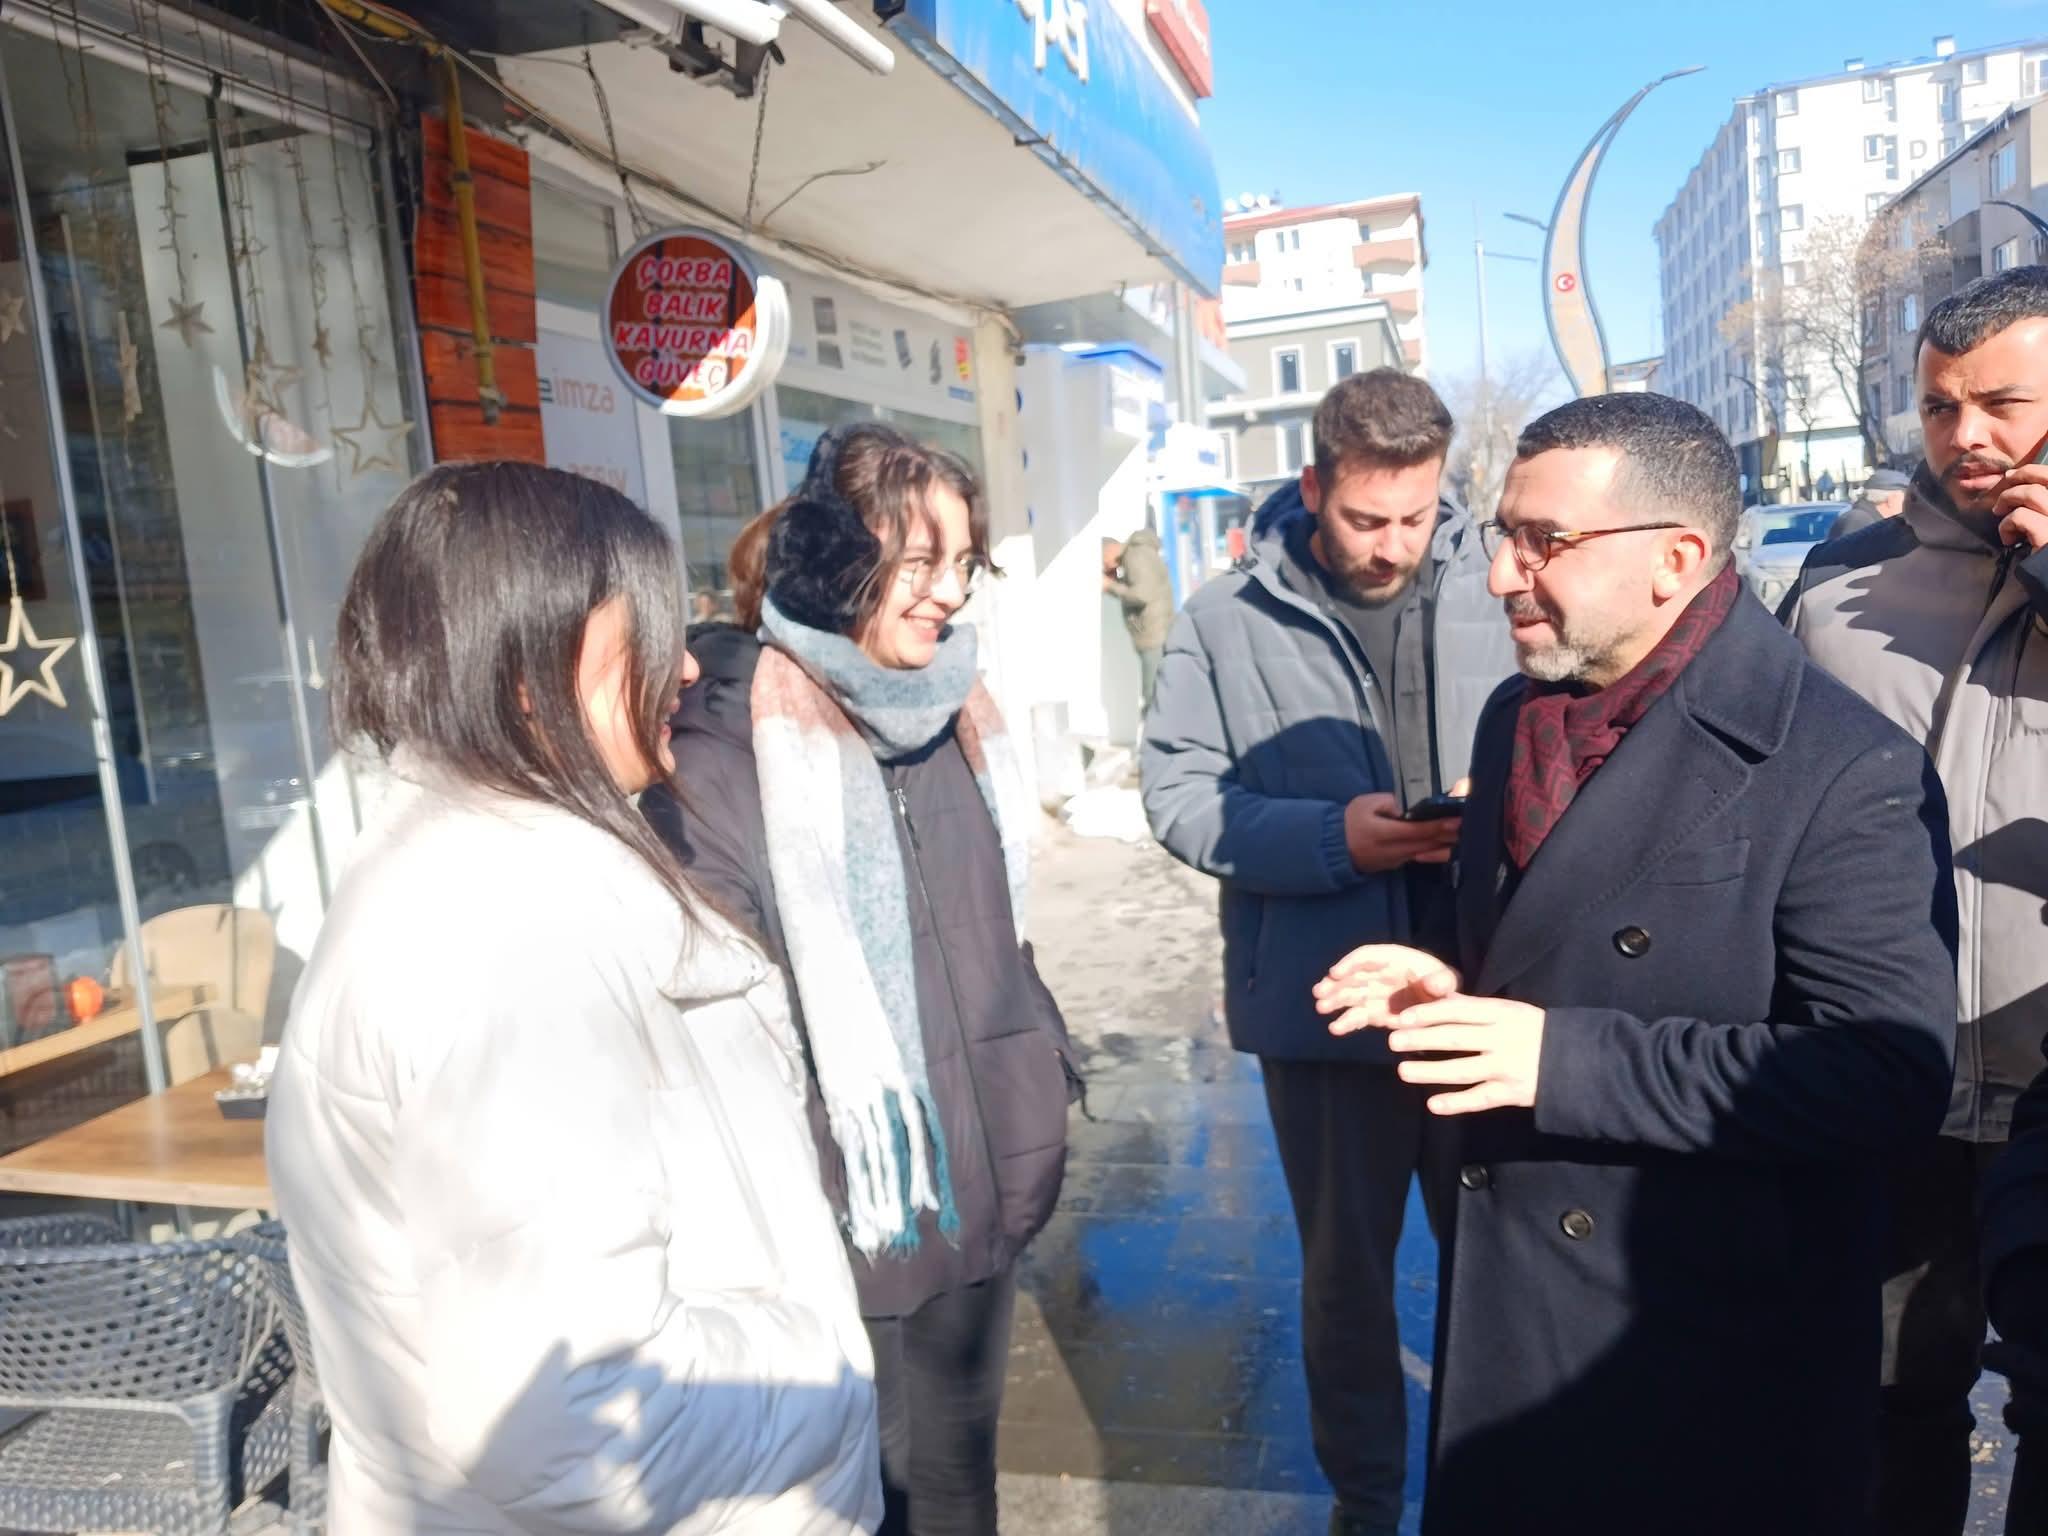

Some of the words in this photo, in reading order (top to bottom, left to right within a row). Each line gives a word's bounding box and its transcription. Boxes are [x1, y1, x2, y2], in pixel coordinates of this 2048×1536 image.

[639, 258, 732, 286] ÇORBA
[647, 292, 723, 318] BALIK
[616, 324, 749, 353] KAVURMA
